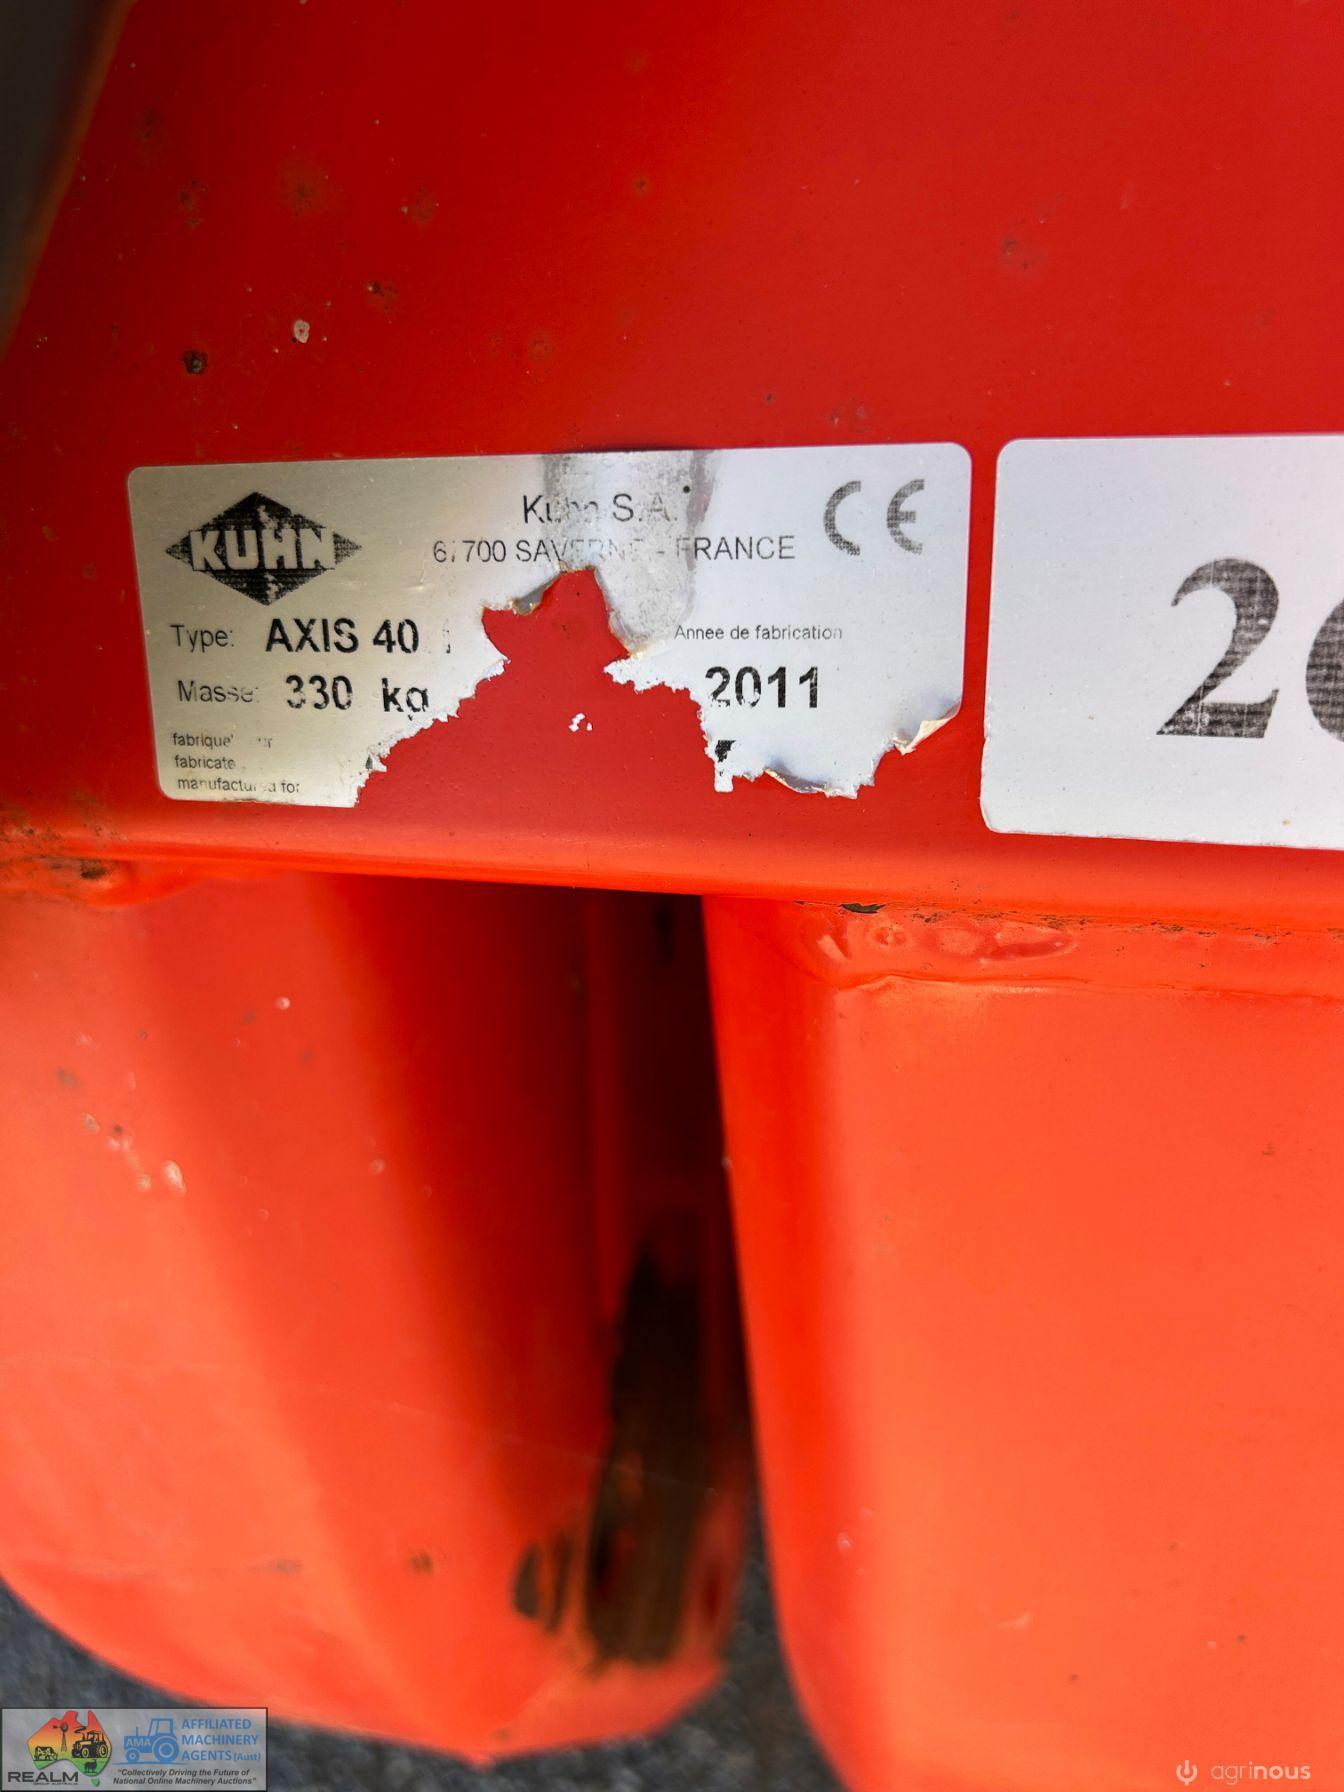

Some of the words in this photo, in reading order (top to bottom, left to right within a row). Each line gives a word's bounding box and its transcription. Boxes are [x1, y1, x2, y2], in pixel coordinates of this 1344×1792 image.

[190, 528, 335, 572] KUHN
[676, 535, 795, 560] FRANCE
[170, 624, 234, 653] Type:
[266, 618, 359, 654] AXIS
[373, 619, 419, 654] 40
[675, 625, 724, 640] Annee
[730, 625, 750, 640] de
[754, 624, 843, 641] fabrication
[285, 675, 353, 711] 330
[381, 677, 429, 721] kg
[704, 666, 820, 710] 2011
